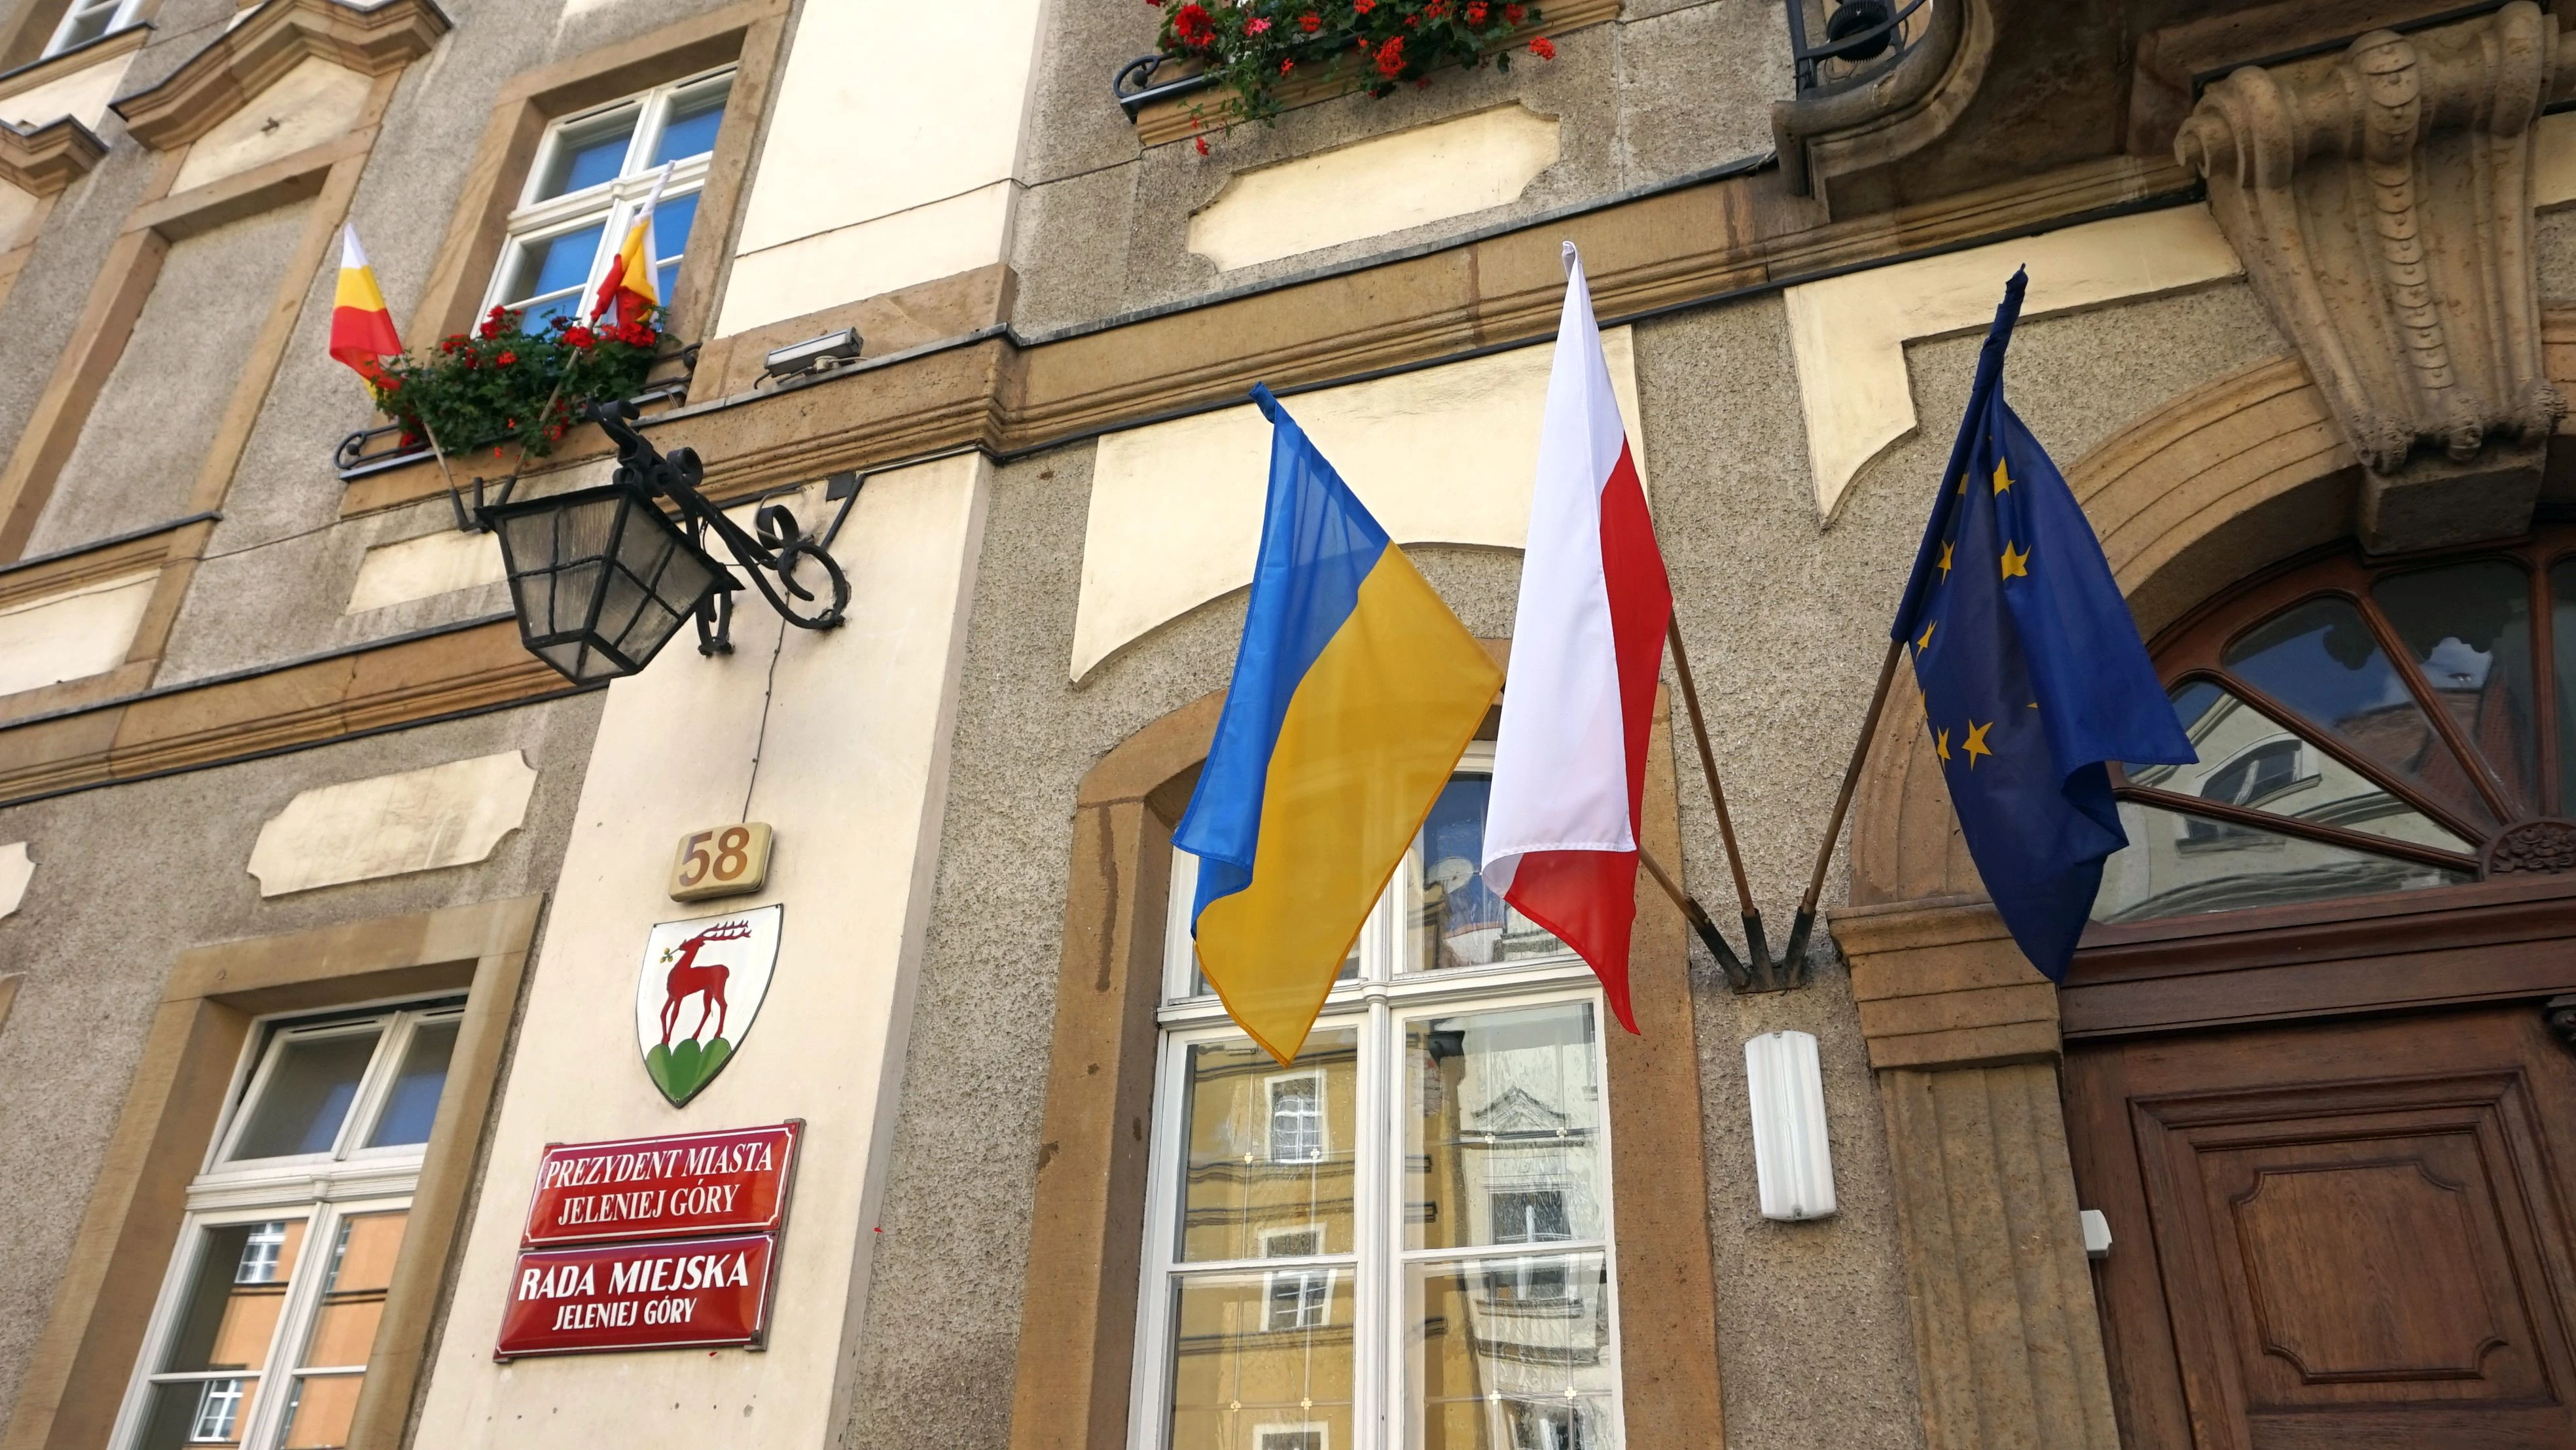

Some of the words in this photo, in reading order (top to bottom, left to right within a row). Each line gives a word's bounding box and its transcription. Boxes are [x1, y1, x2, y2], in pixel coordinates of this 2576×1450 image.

[679, 826, 750, 887] 58
[543, 1149, 683, 1190] PREZYDENT
[681, 1142, 773, 1177] MIASTA
[558, 1190, 667, 1226] JELENIEJ
[670, 1179, 740, 1216] GÓRY
[518, 1264, 595, 1301] RADA
[608, 1251, 749, 1296] MIEJSKA
[552, 1300, 639, 1331] JELENIEJ
[644, 1295, 698, 1325] GÓRY
